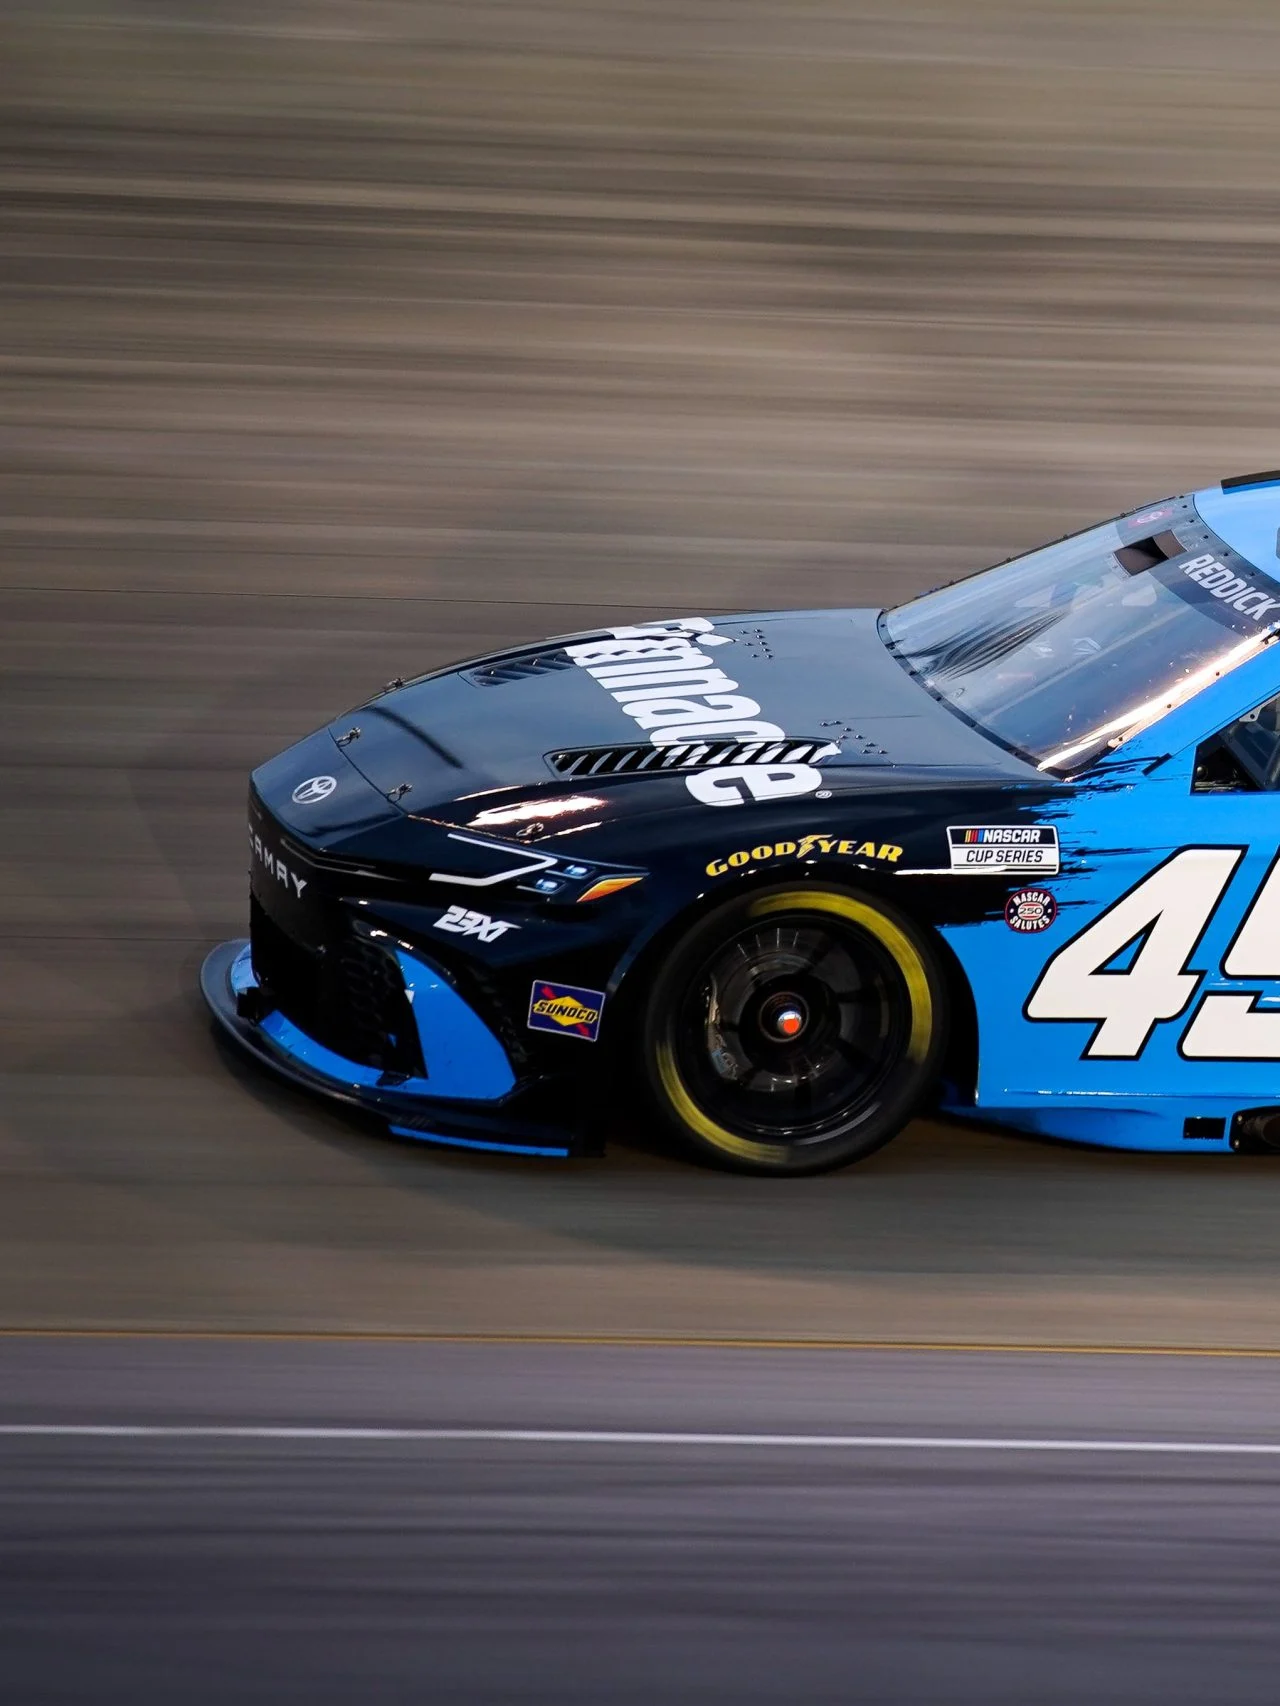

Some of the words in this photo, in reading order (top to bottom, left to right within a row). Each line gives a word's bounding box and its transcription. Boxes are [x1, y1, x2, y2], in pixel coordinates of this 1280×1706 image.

[983, 829, 1041, 843] NASCAR
[966, 850, 994, 863] CUP
[995, 850, 1044, 863] SERIES
[1012, 892, 1050, 906] NASCAR
[1018, 907, 1043, 915] 250
[1009, 915, 1050, 930] SALUTES
[536, 1000, 598, 1022] SUNOCO
